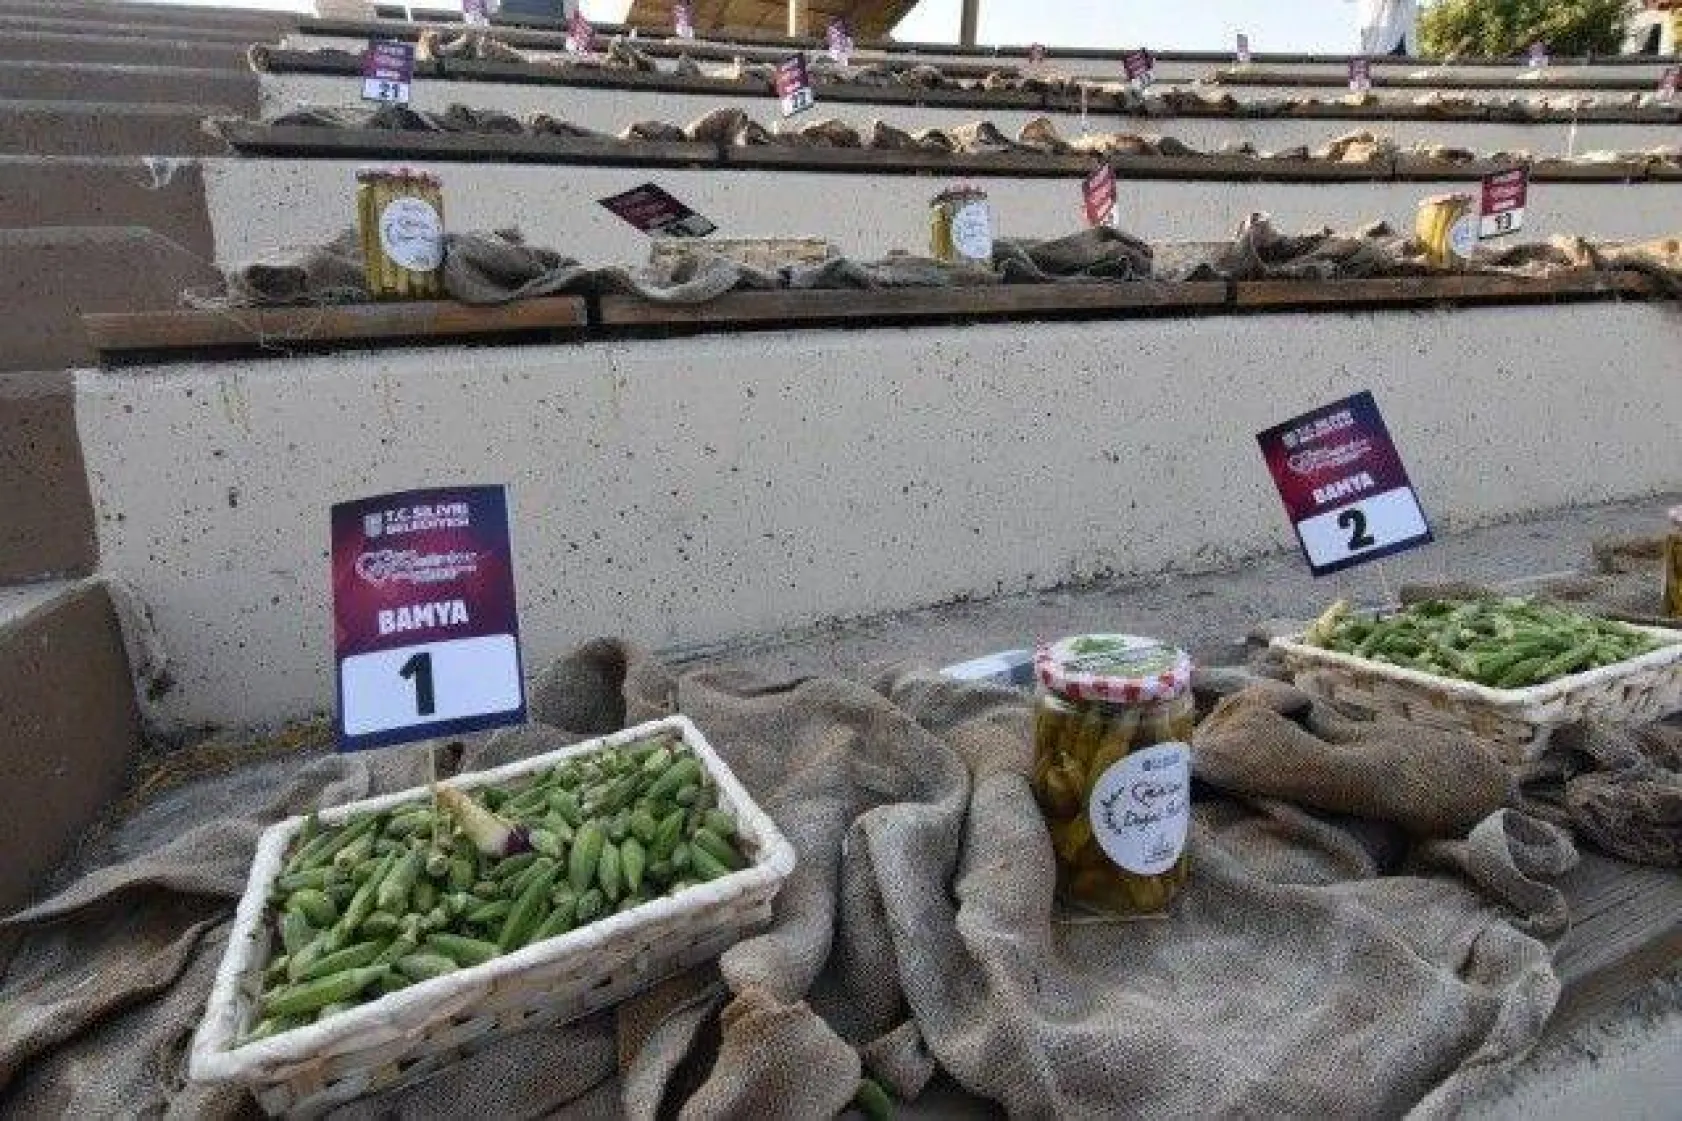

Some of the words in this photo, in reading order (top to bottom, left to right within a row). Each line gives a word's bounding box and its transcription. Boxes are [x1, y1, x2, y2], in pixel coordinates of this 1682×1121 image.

[378, 81, 399, 98] 21
[1337, 508, 1375, 551] 2
[378, 600, 469, 634] BAMYA
[398, 652, 436, 717] 1
